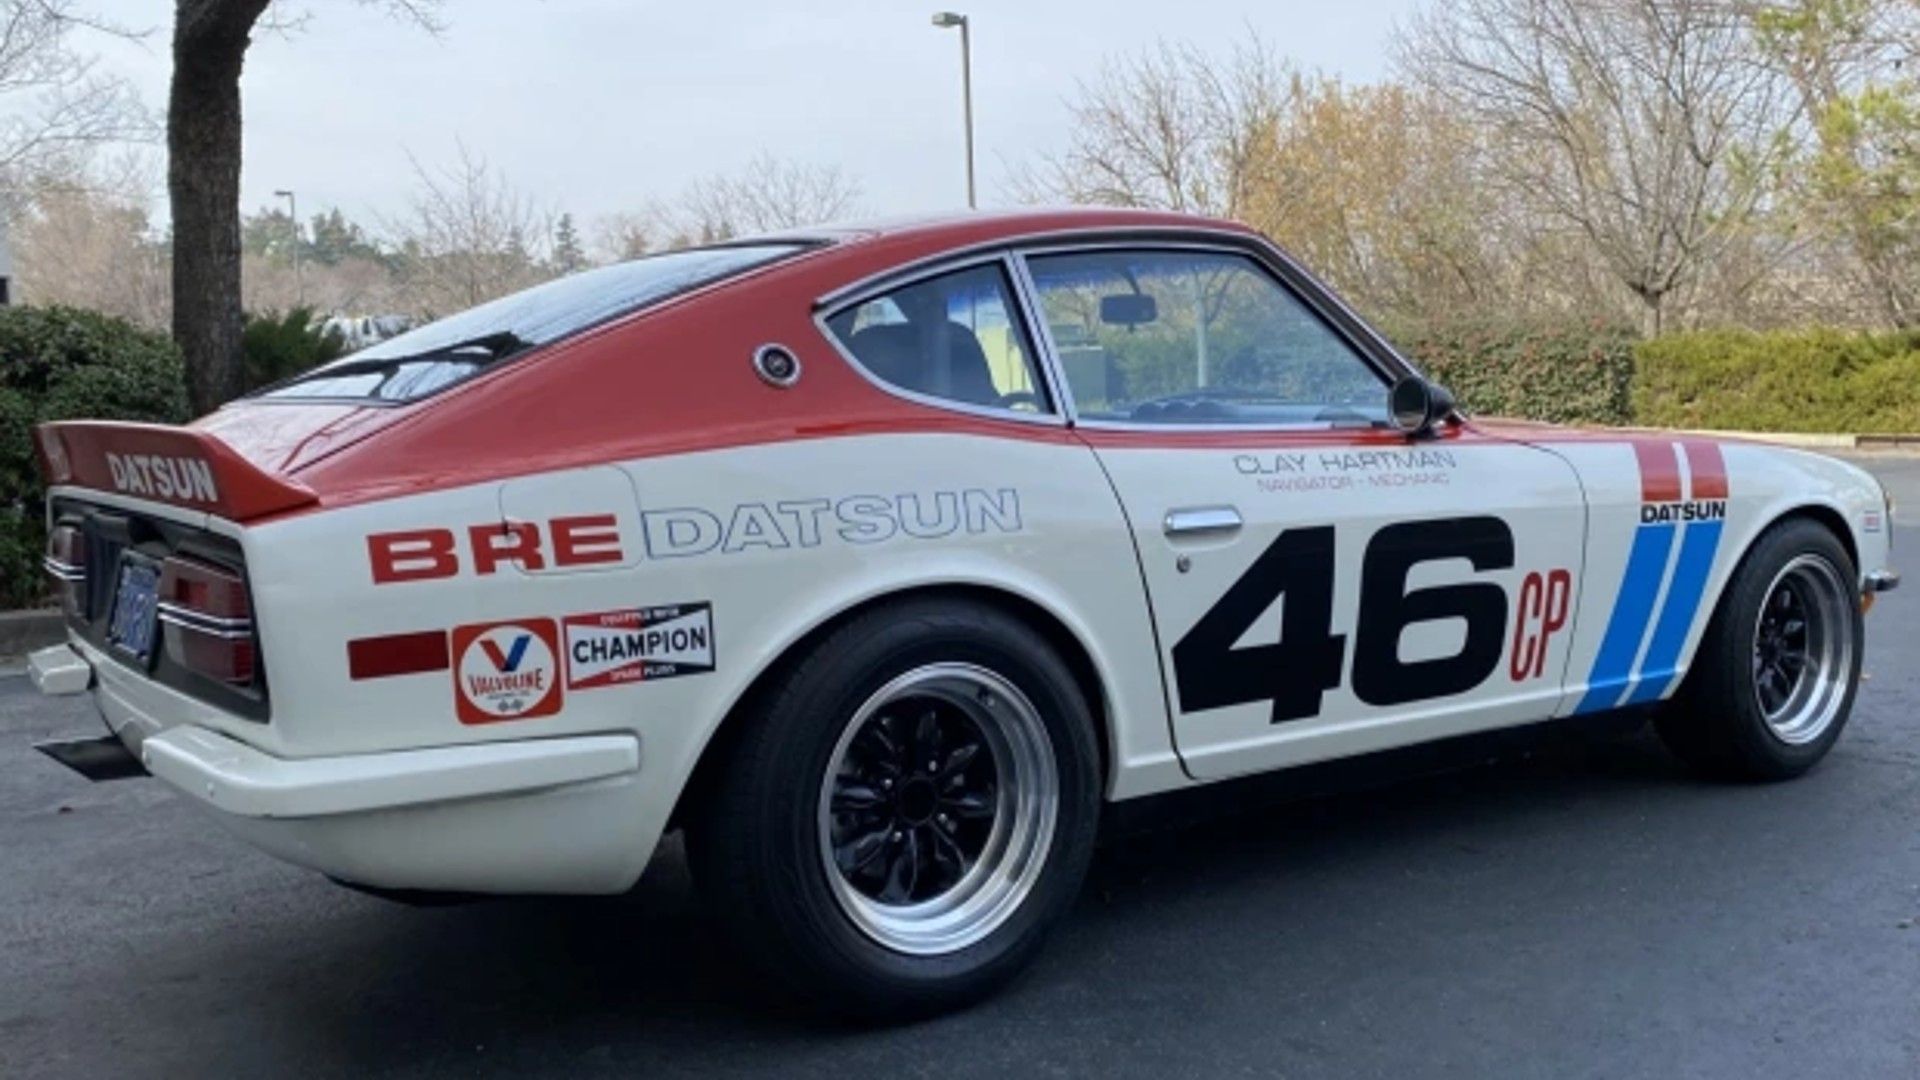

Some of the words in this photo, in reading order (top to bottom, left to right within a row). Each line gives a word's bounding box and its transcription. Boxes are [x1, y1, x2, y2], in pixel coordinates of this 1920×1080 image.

[105, 452, 217, 502] DATSUN
[1233, 454, 1305, 474] CLAY
[1319, 451, 1456, 471] HARTMAN
[1640, 501, 1726, 524] DATSUN
[366, 514, 624, 585] BRE
[641, 488, 1022, 560] DATSUN
[1171, 515, 1515, 724] 46
[1510, 569, 1571, 682] CP
[573, 626, 707, 663] CHAMPION
[468, 667, 545, 696] VALVOLINE
